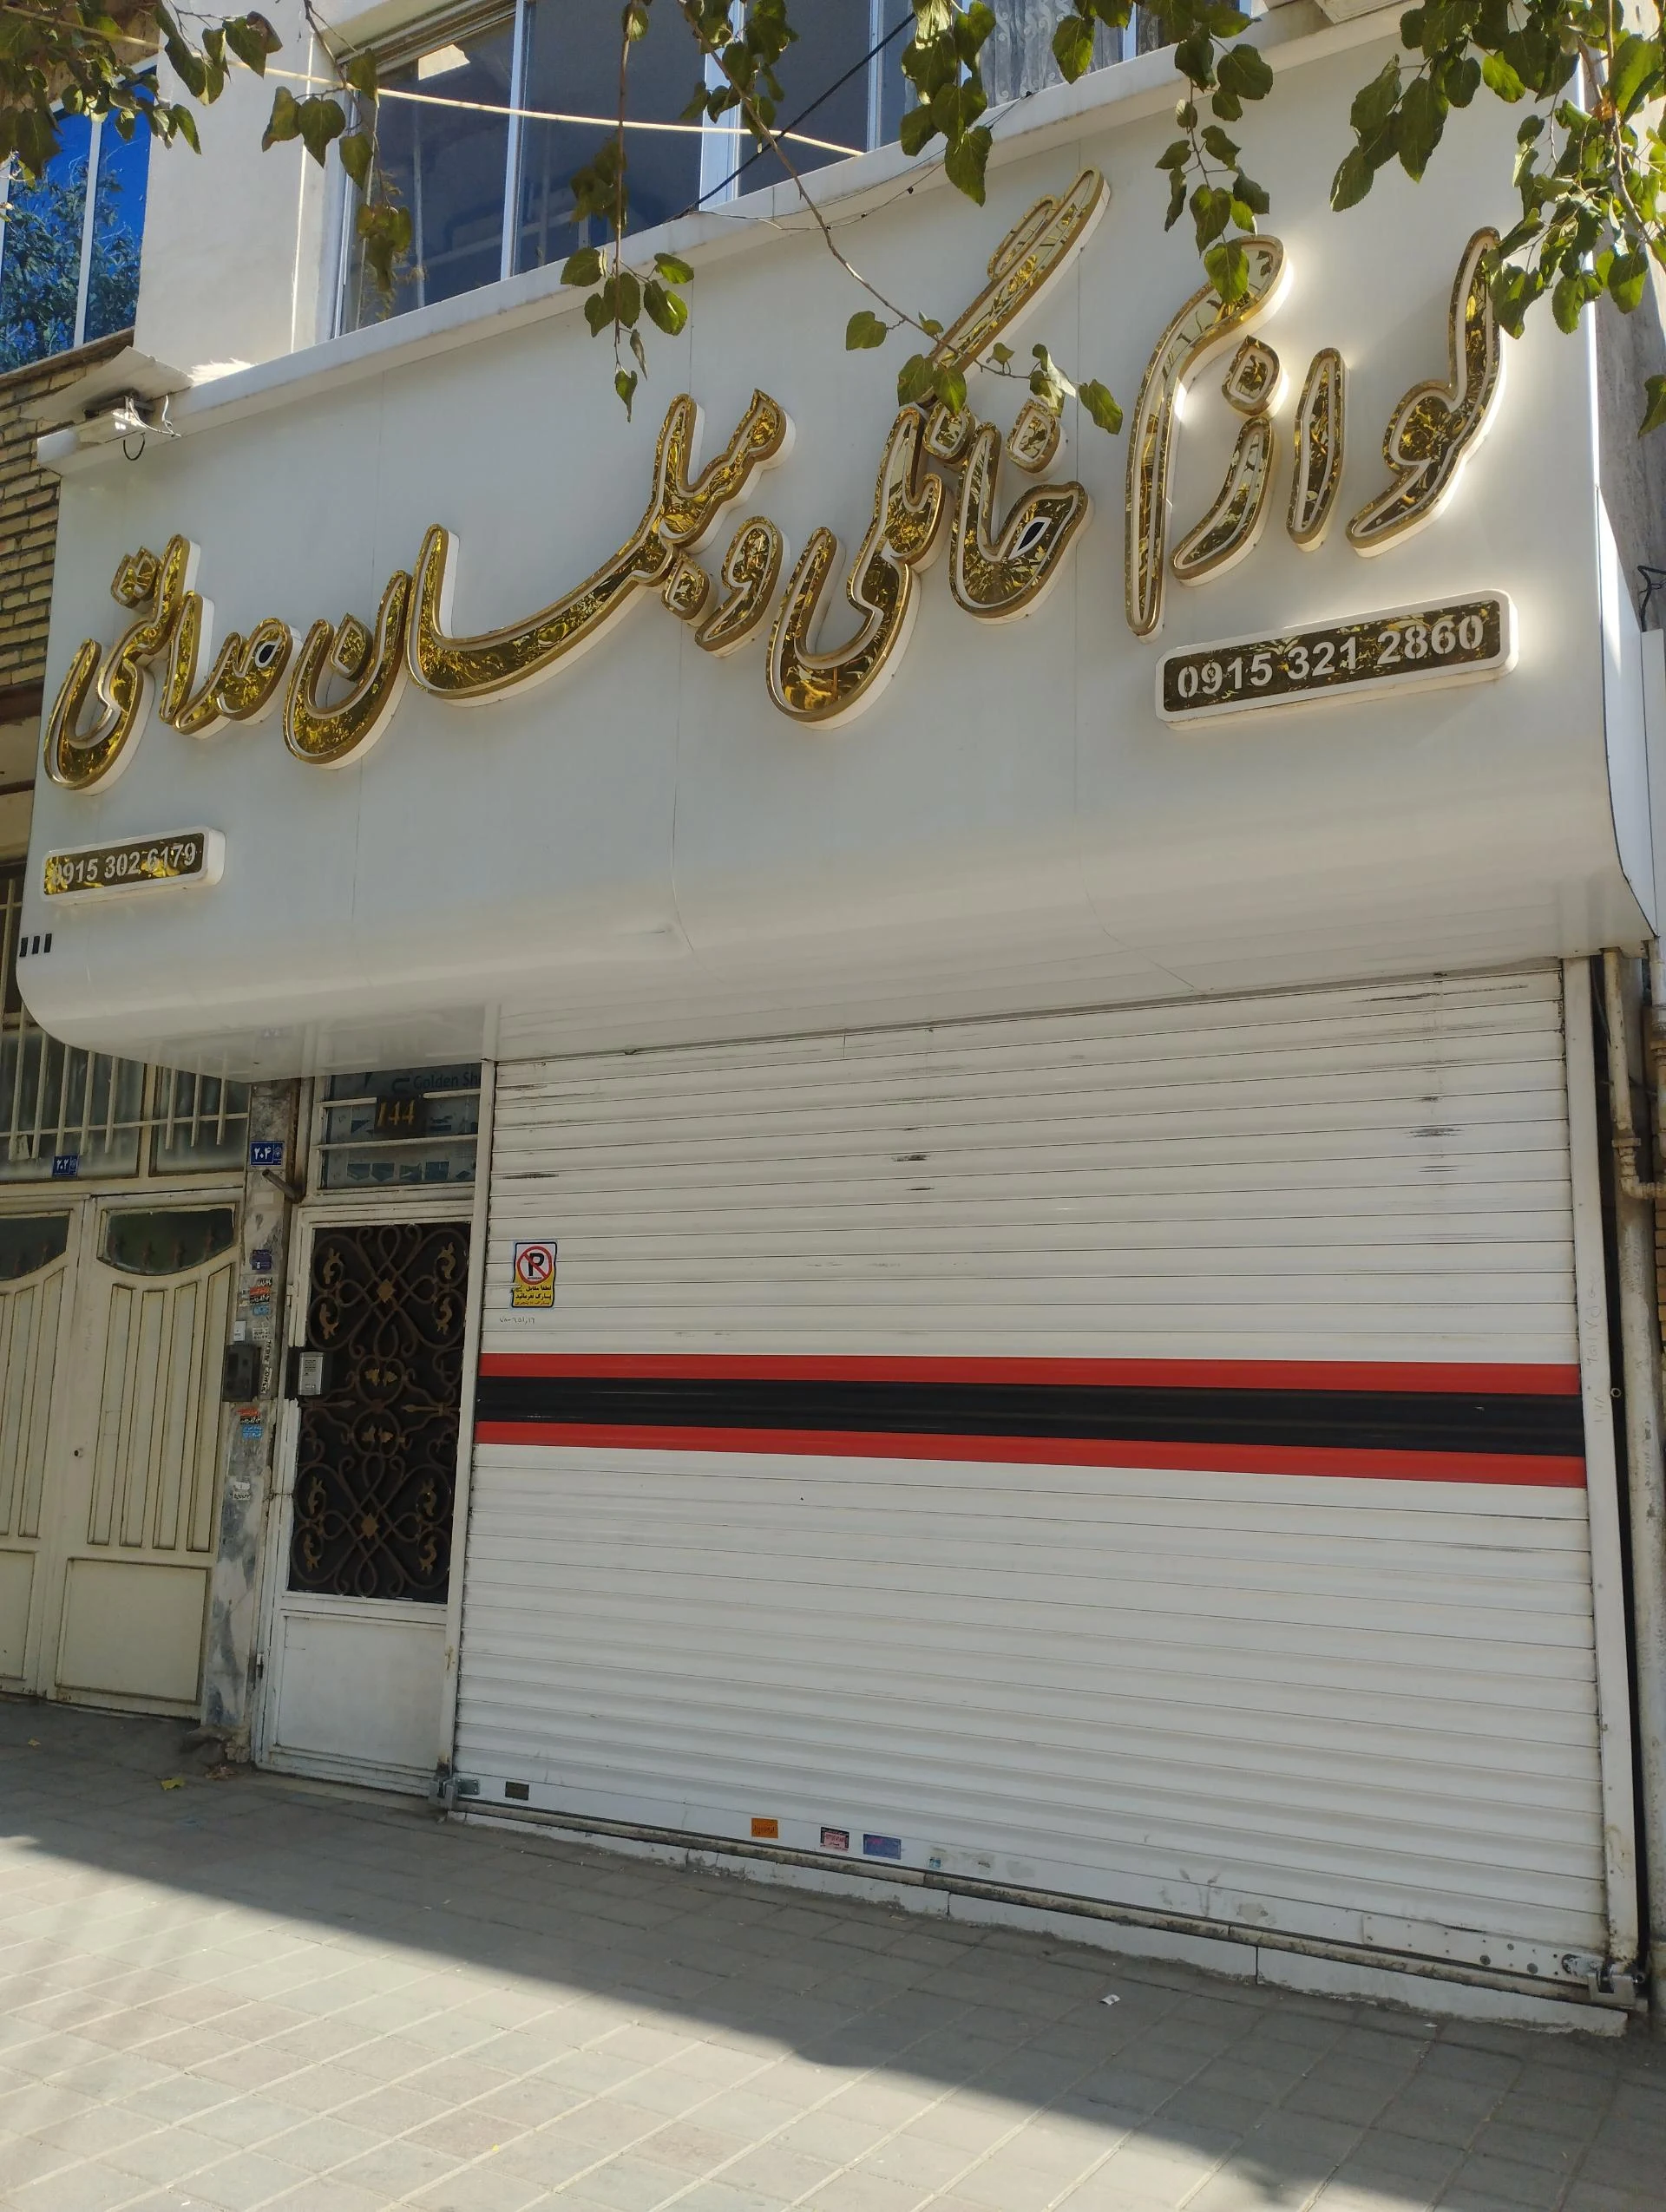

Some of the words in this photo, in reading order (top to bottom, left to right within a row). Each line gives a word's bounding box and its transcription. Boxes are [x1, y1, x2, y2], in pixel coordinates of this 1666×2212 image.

[765, 166, 1106, 727] خانگی
[1125, 227, 1502, 638] لوازم
[1177, 651, 1274, 698] 0915
[1286, 635, 1358, 680] 321
[1376, 614, 1485, 665] 2860
[51, 857, 100, 886] 0915
[103, 850, 141, 880] 302
[146, 841, 197, 874] 6179
[413, 1073, 459, 1090] Golden
